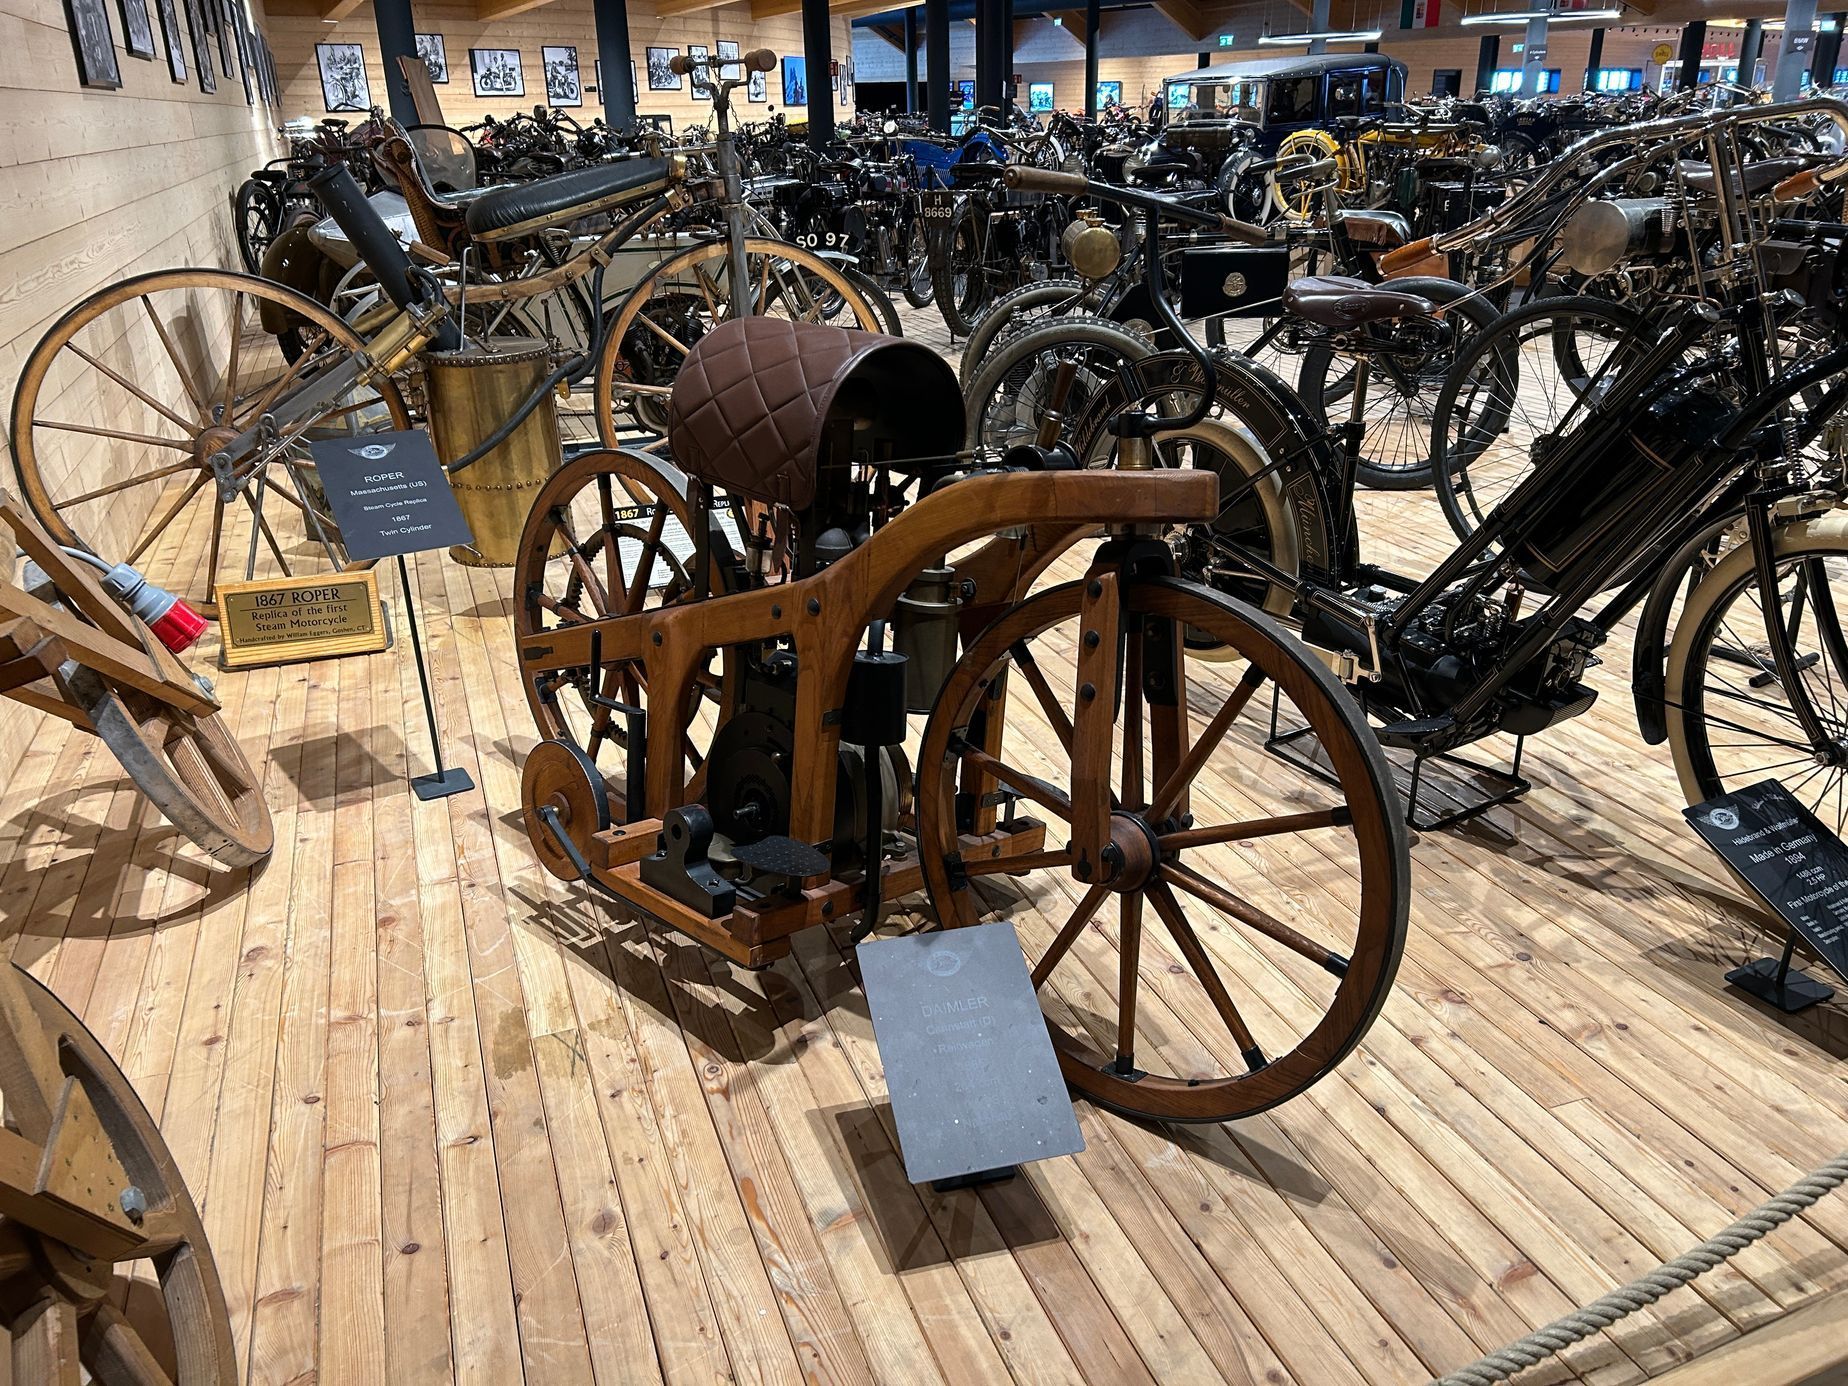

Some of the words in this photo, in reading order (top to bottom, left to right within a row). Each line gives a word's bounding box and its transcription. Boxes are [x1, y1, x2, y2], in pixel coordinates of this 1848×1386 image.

[934, 194, 942, 205] H
[924, 207, 952, 218] 8669
[796, 233, 818, 249] SO
[825, 232, 850, 248] 97
[364, 471, 404, 483] ROPER
[350, 484, 408, 497] Massachusetts
[409, 480, 427, 489] (US)
[363, 504, 385, 512] Steam
[385, 501, 403, 509] Cycle
[403, 497, 428, 506] Replica
[614, 508, 639, 520] 1867
[380, 529, 399, 537] Twin
[400, 523, 432, 534] Cylinder
[255, 593, 285, 607] 1867
[292, 587, 341, 603] ROPER
[252, 610, 288, 621] Replica
[292, 606, 301, 617] of
[307, 604, 322, 615] the
[327, 603, 348, 613] first
[256, 622, 286, 632] Steam
[290, 614, 347, 628] Motorcycle
[239, 634, 276, 644] Handcrafted
[1748, 849, 1775, 864] Made
[1771, 846, 1783, 855] in
[1780, 833, 1818, 851] Germany
[1784, 851, 1807, 865] 1894
[1815, 873, 1826, 882] HP
[1787, 899, 1804, 909] First
[1800, 886, 1835, 903] Motorcycle
[1832, 882, 1841, 891] of
[920, 996, 990, 1018] DAIMLER
